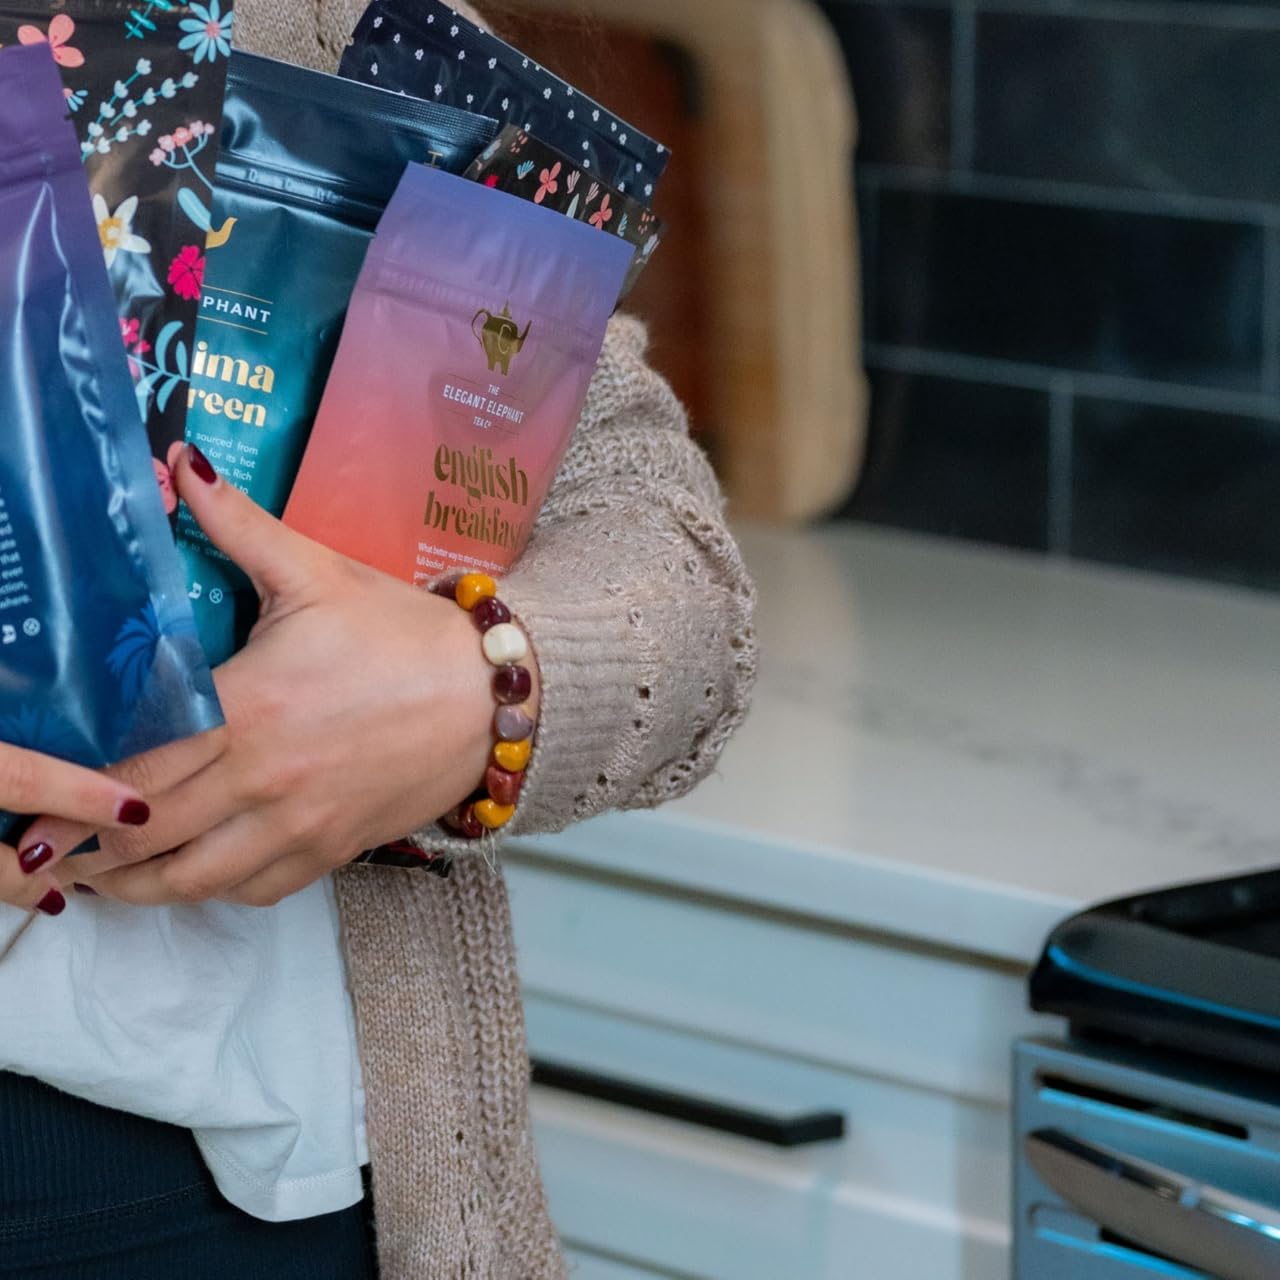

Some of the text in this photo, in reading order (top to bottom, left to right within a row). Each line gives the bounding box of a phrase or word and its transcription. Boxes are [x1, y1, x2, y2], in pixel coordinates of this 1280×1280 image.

[202, 296, 271, 324] PHANT
[192, 340, 276, 394] ima
[488, 383, 501, 396] THE
[187, 387, 267, 428] reen
[442, 384, 524, 424] ELEGANT ELEPHANT
[473, 416, 484, 428] TEA
[196, 432, 233, 449] sourced
[237, 441, 259, 456] from
[208, 447, 222, 459] for
[240, 455, 257, 469] hot
[233, 467, 253, 482] Rich
[434, 443, 528, 508] english
